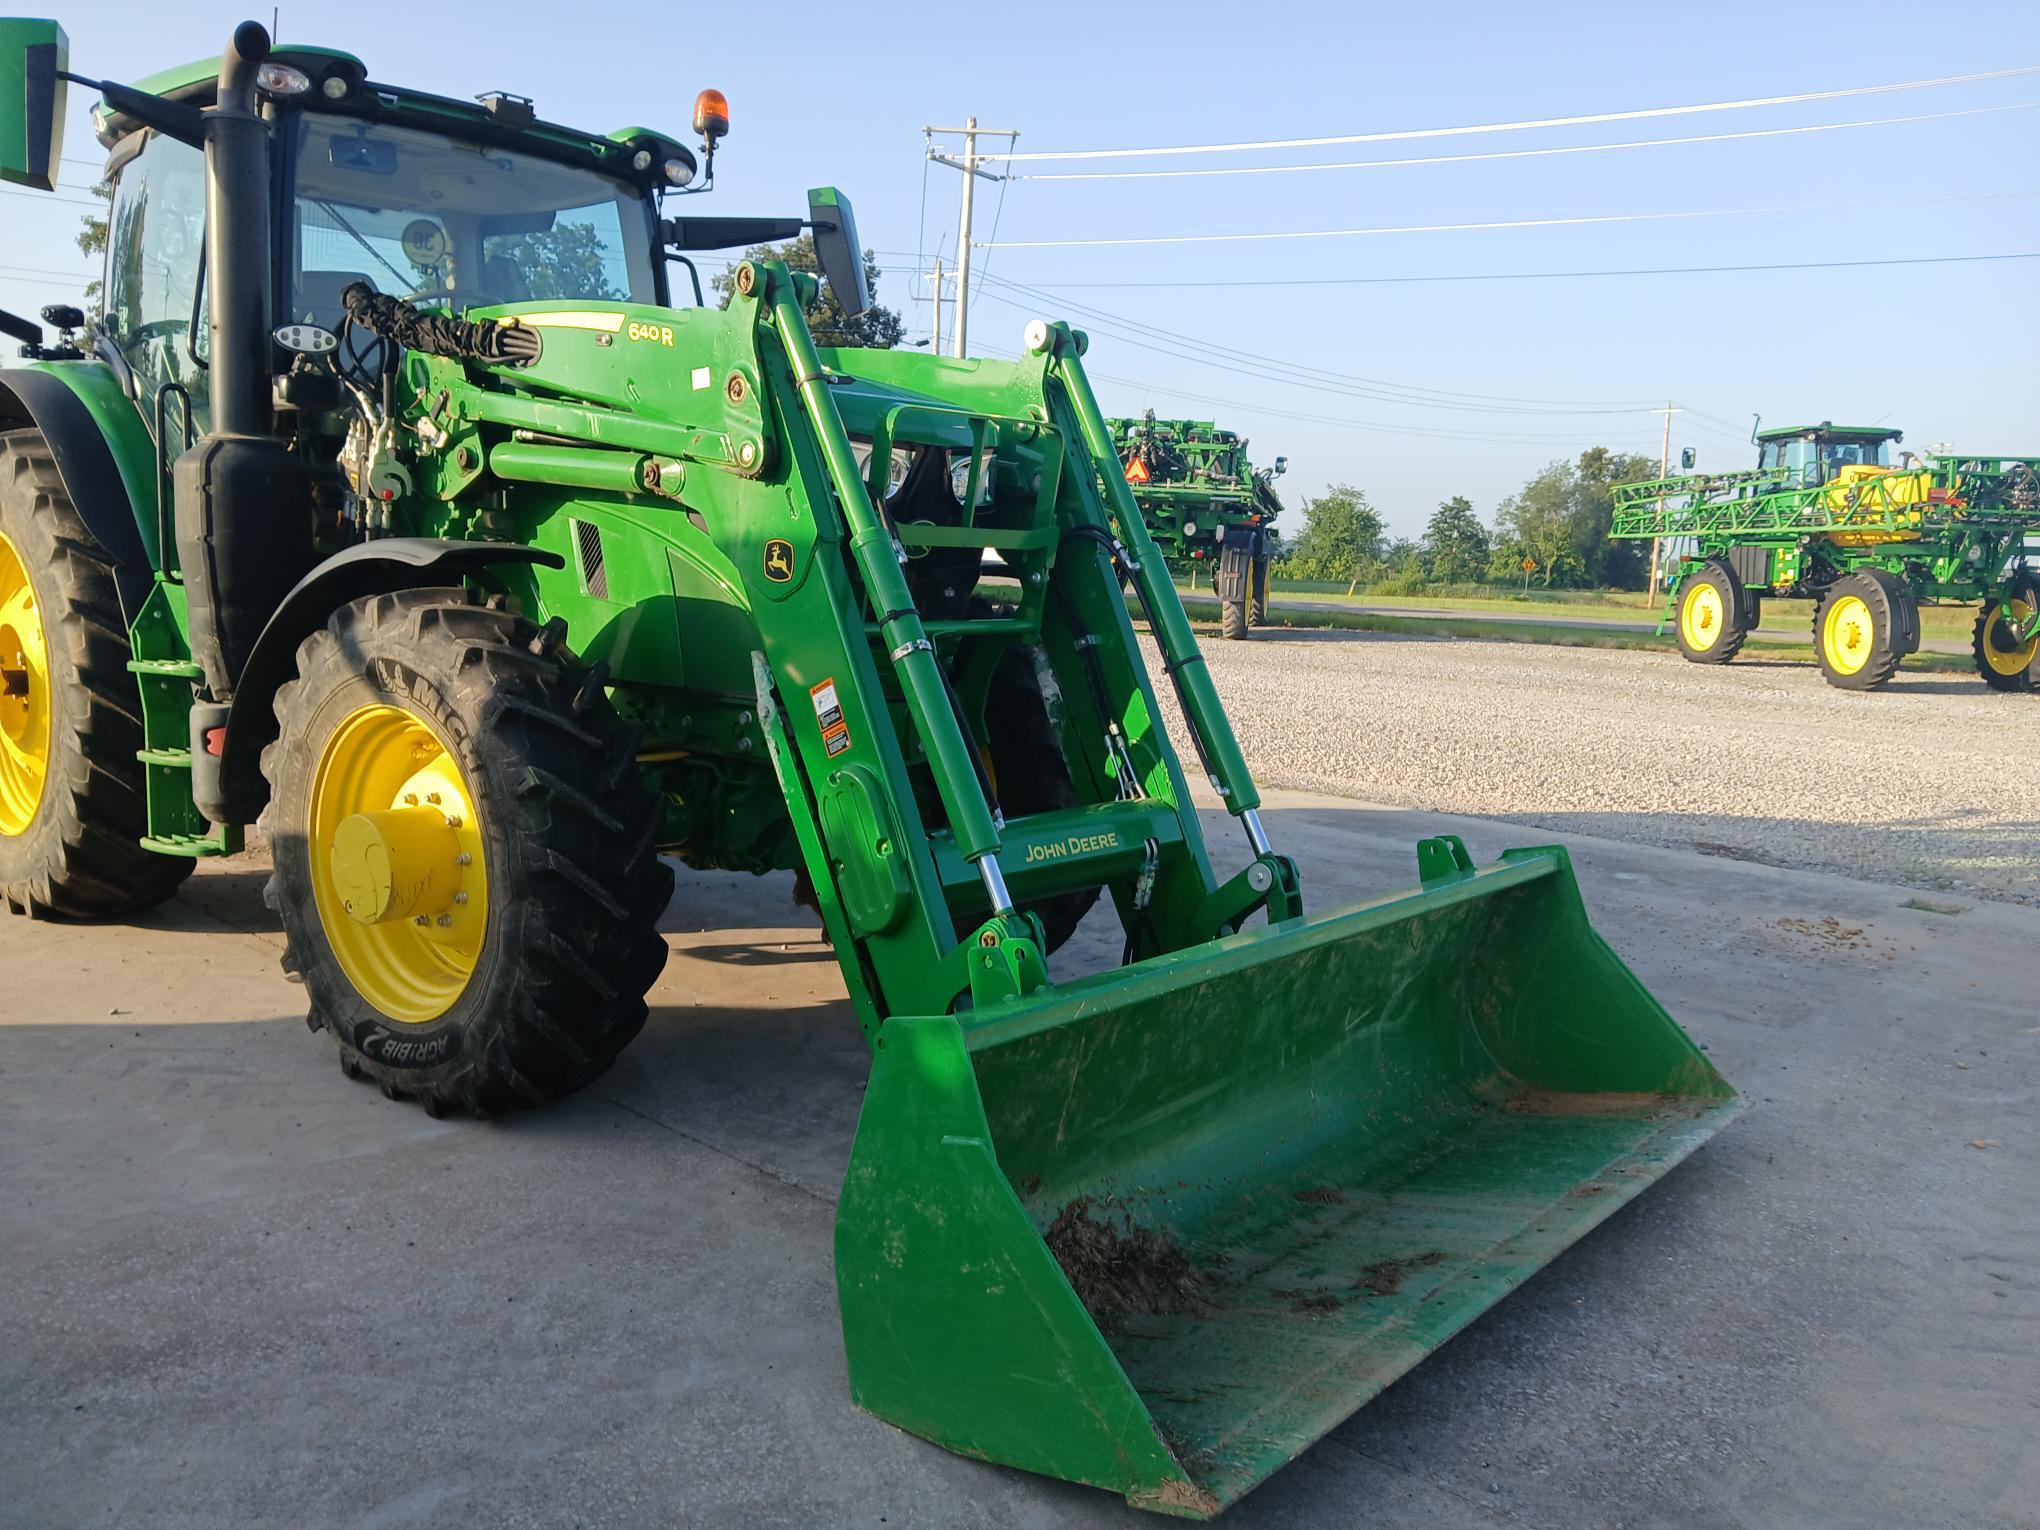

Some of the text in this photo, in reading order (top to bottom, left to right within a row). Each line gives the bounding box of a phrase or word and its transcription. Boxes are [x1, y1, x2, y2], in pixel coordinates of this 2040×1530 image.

[1025, 833, 1118, 863] JOHN DEERE
[363, 1025, 448, 1061] AGRIBIB 2
